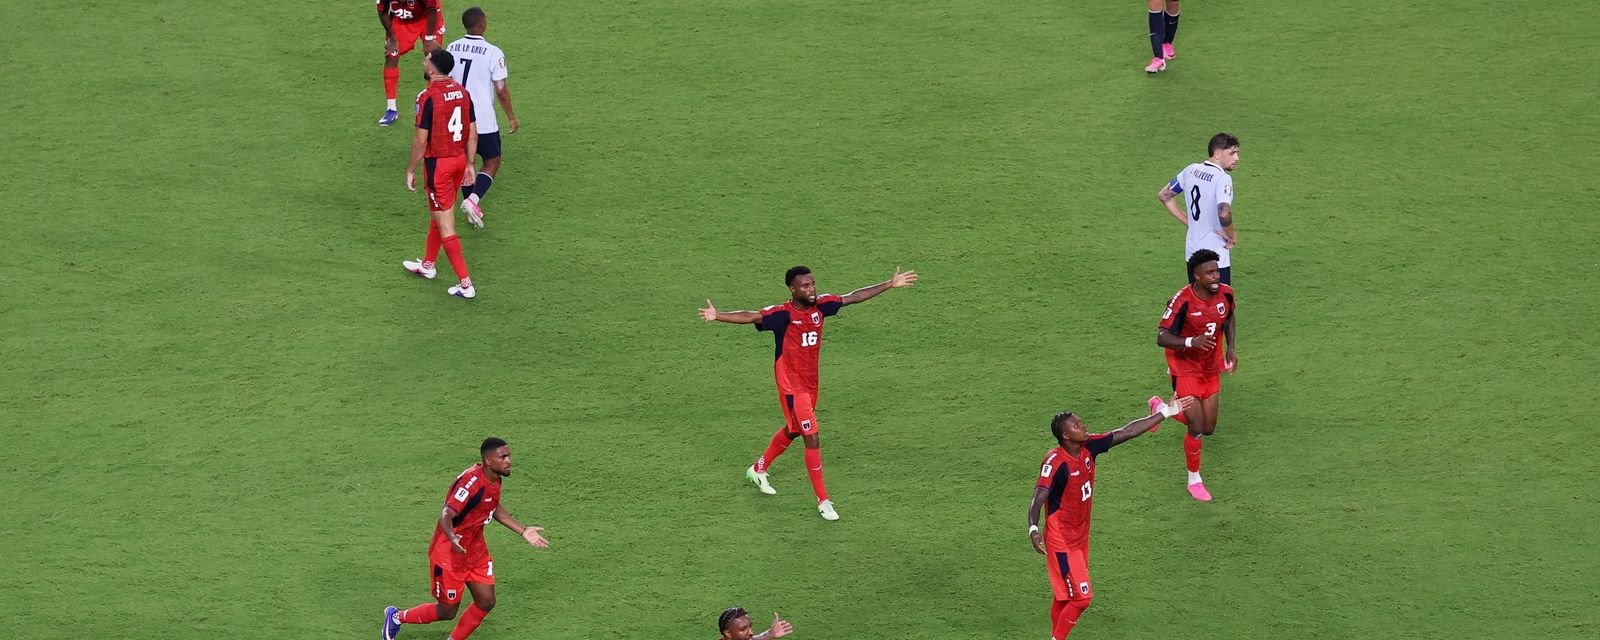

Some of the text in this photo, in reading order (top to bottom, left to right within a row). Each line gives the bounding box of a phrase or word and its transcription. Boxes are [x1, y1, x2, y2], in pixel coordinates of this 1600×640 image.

[460, 58, 473, 88] 7
[443, 90, 464, 101] LOPES
[447, 105, 464, 142] 4
[1190, 184, 1201, 221] 8
[801, 331, 818, 347] 16
[1204, 322, 1217, 336] 3
[1081, 480, 1092, 502] 13
